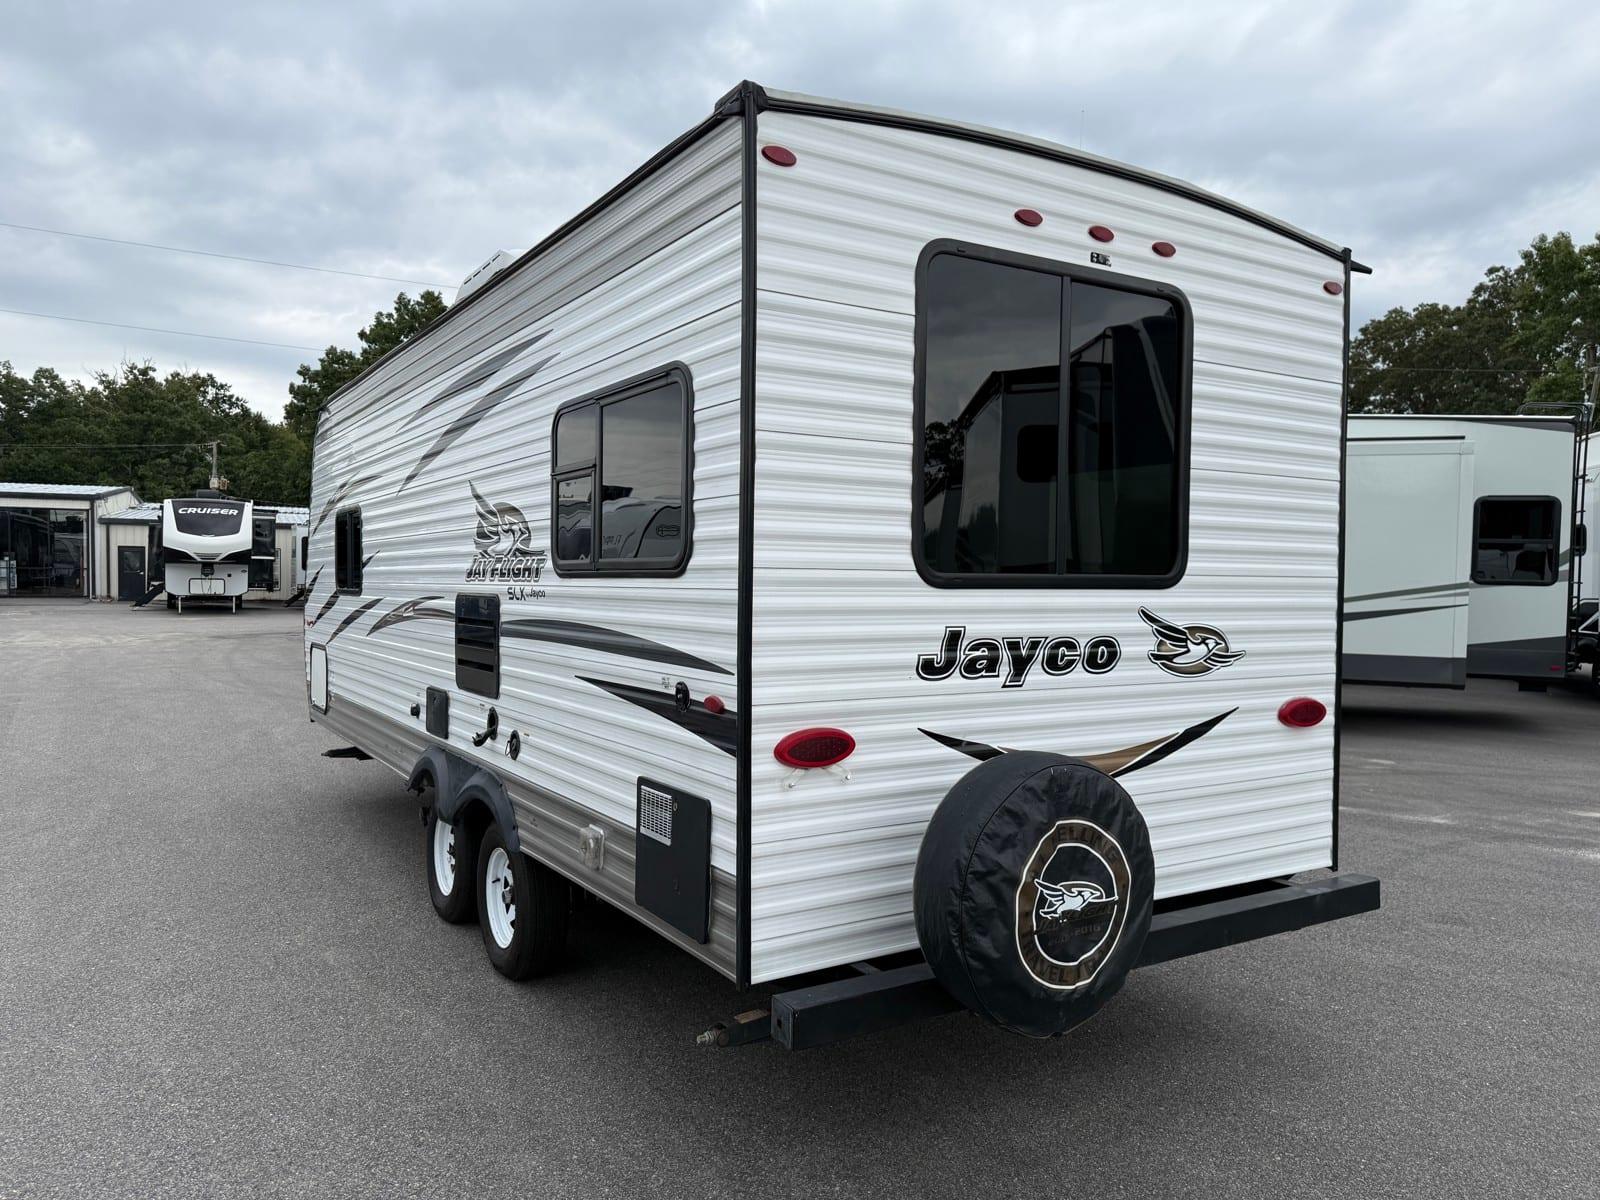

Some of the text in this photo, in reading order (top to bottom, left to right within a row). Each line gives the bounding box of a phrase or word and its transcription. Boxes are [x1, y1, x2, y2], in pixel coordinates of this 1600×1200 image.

[178, 507, 239, 515] CRUISER
[466, 553, 547, 582] JAY FLIGHT
[915, 626, 1122, 688] Jayco
